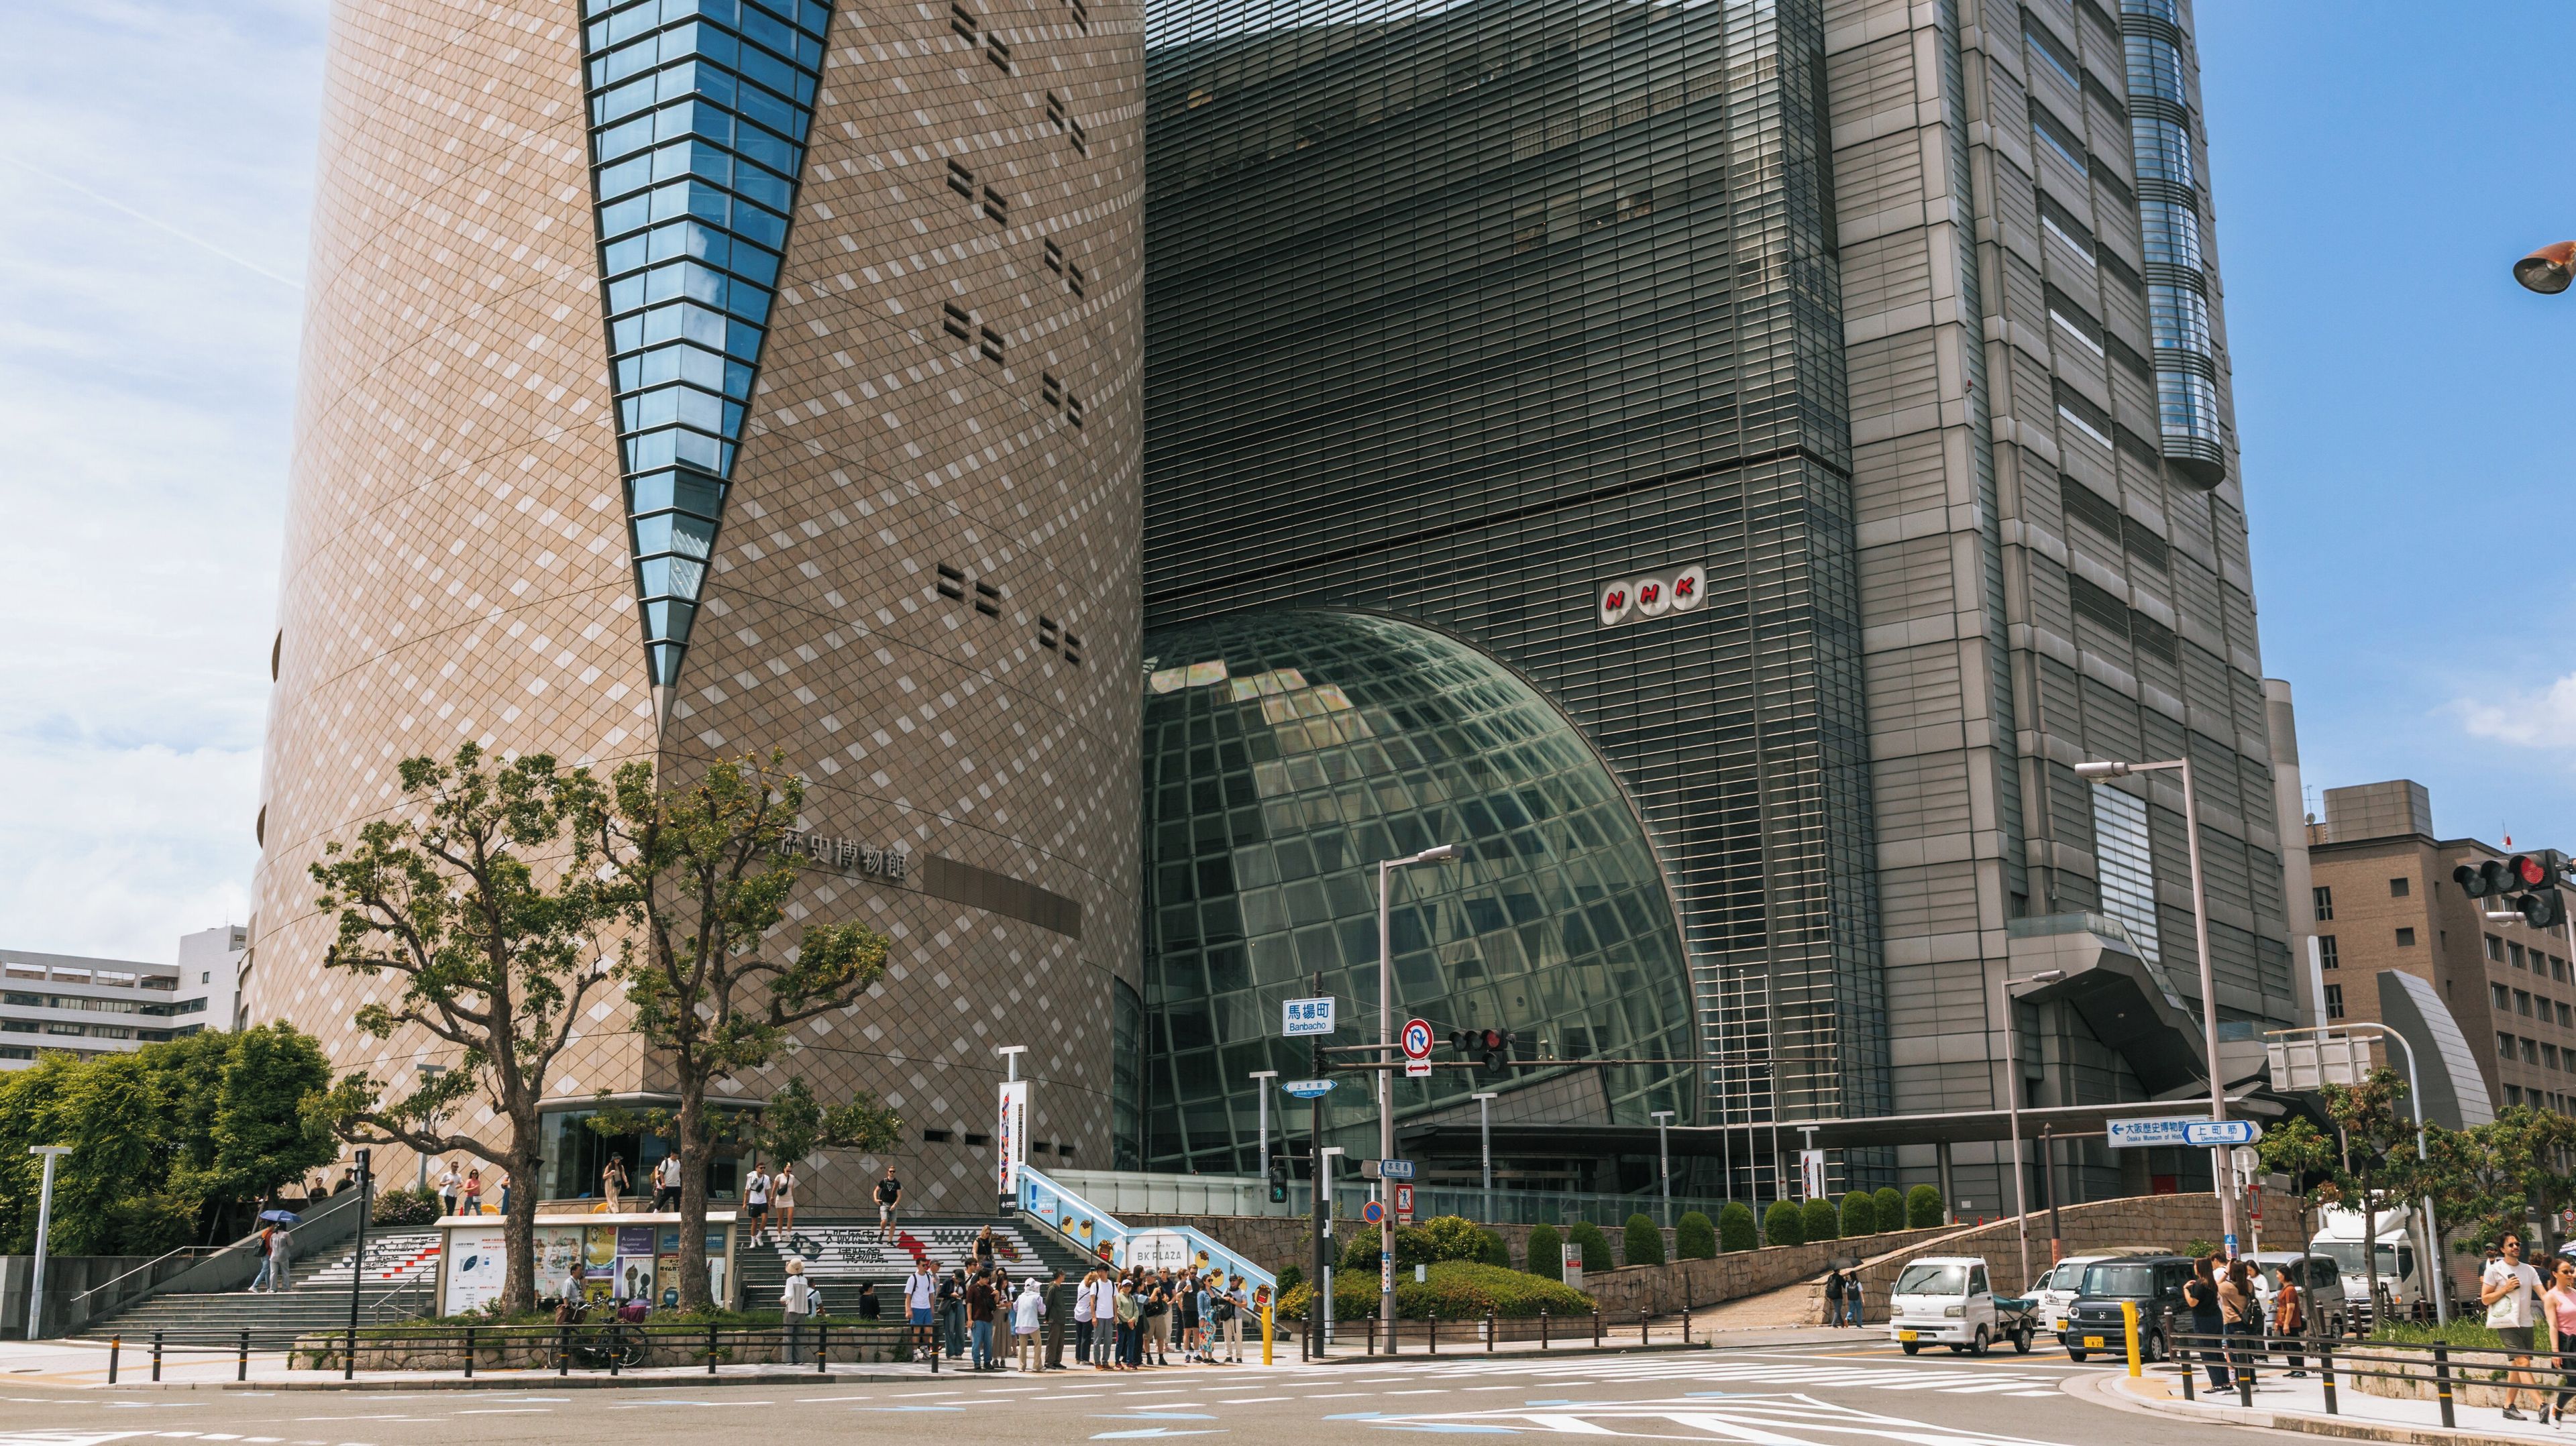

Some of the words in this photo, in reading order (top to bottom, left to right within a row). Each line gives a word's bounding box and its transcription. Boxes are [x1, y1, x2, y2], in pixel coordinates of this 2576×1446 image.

[1606, 577, 1695, 610] NHK
[1288, 1003, 1330, 1019] 馬場町
[1289, 1021, 1326, 1032] Banbacho
[2126, 1121, 2186, 1134] 大阪歴史博物館
[2198, 1125, 2237, 1135] 上町筋
[2201, 1134, 2235, 1143] Uemachisuji
[1138, 1252, 1149, 1260] BK
[1152, 1251, 1181, 1260] PLAZA
